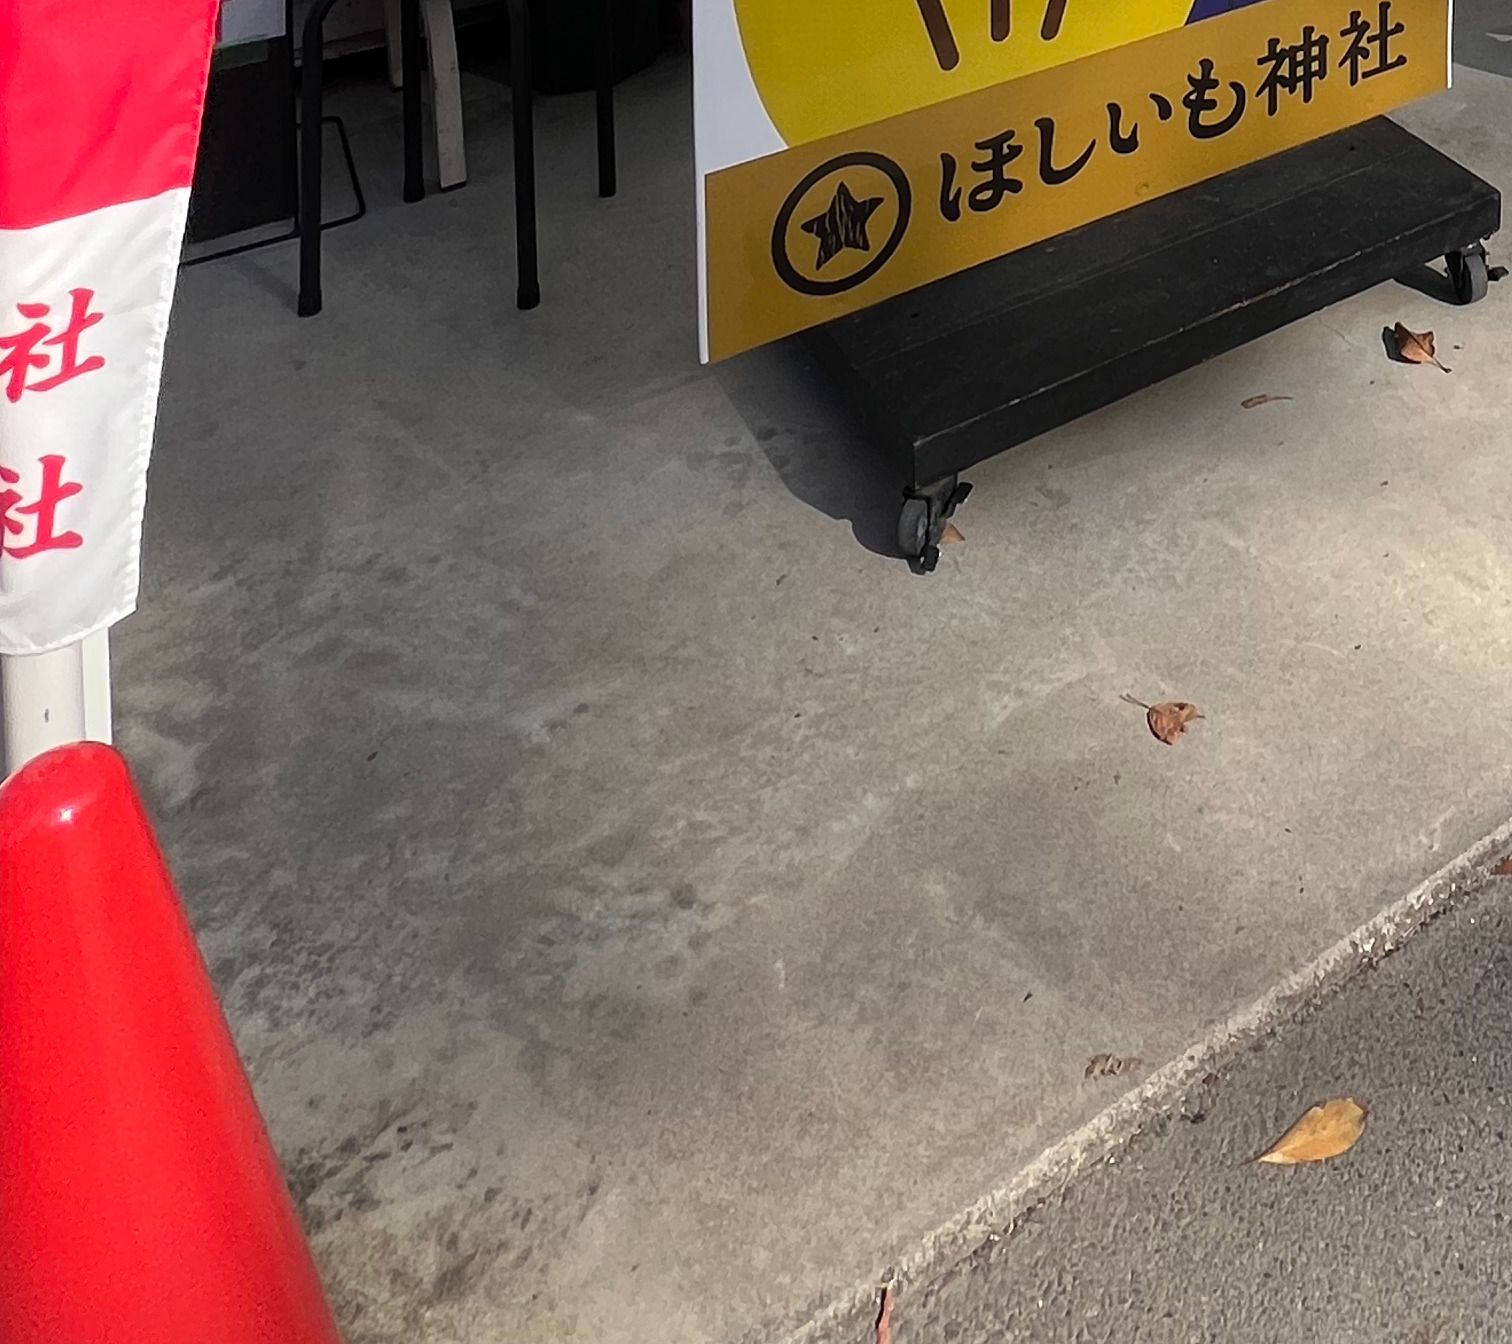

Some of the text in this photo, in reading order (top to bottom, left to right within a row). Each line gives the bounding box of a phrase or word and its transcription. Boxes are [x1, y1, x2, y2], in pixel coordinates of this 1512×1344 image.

[938, 1, 1409, 222] ほしいも神社
